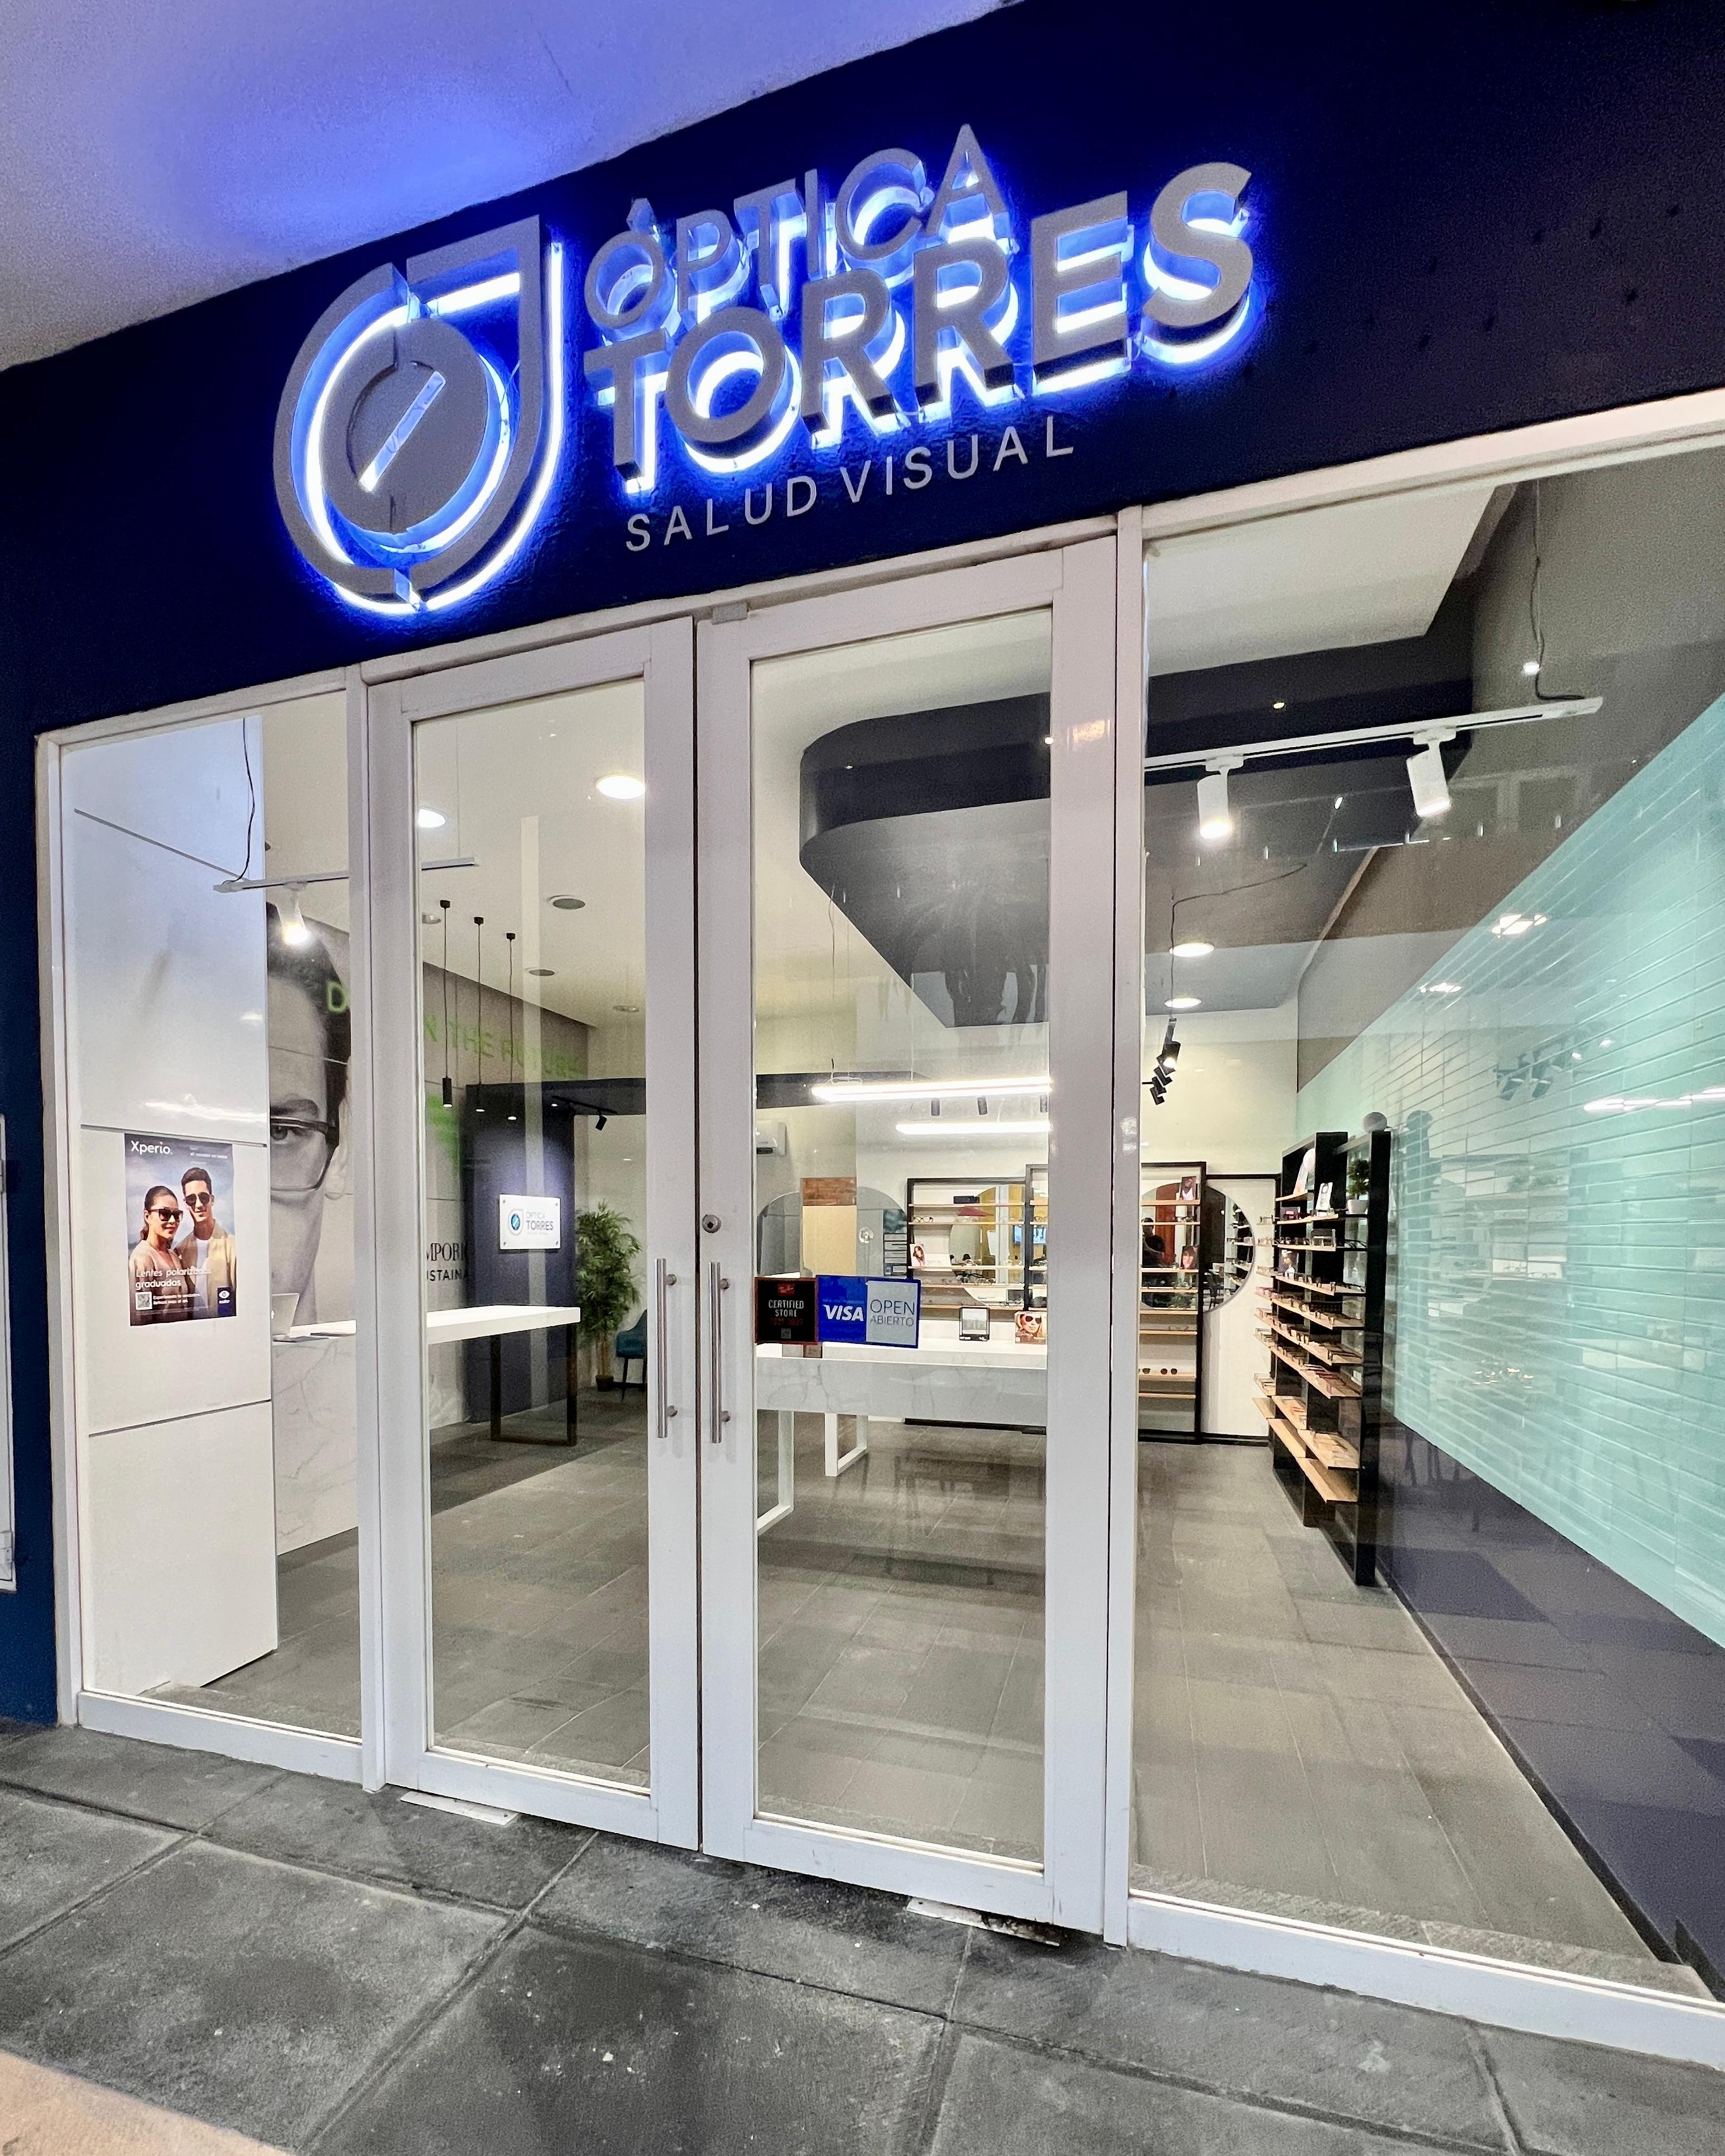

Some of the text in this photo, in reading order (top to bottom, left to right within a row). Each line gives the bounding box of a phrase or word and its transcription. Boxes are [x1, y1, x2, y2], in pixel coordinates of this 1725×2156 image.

[584, 124, 1009, 329] ÓPTICA
[583, 161, 1253, 477] TORRES
[626, 415, 1075, 552] SALUD VISUAL
[130, 1140, 171, 1155] Xperio
[526, 1220, 554, 1231] TORRES
[136, 1269, 163, 1277] Lentes
[135, 1279, 182, 1290] graduadas
[768, 1299, 805, 1309] CERTIFIED
[870, 1299, 915, 1315] OPEN
[775, 1309, 798, 1317] STORE
[822, 1304, 864, 1322] VISA
[870, 1315, 914, 1327] ABIERTO
